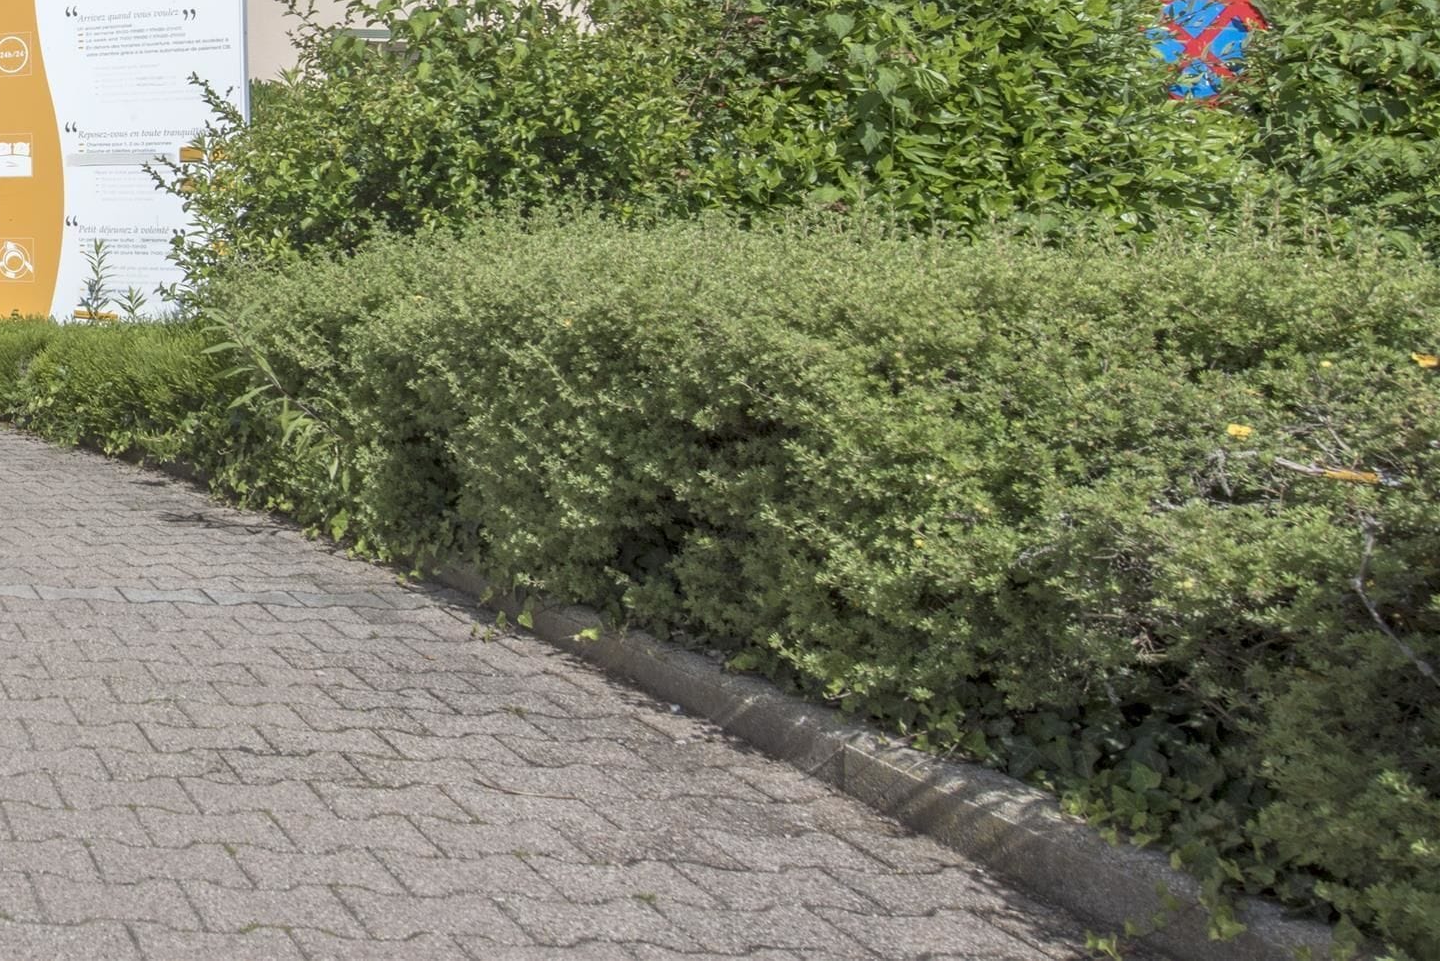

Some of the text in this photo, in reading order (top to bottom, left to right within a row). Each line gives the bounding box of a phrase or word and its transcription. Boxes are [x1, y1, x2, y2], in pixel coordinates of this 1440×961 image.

[107, 11, 131, 23] quand
[133, 10, 152, 19] vous
[153, 7, 179, 18] voulez
[78, 225, 96, 234] Petit
